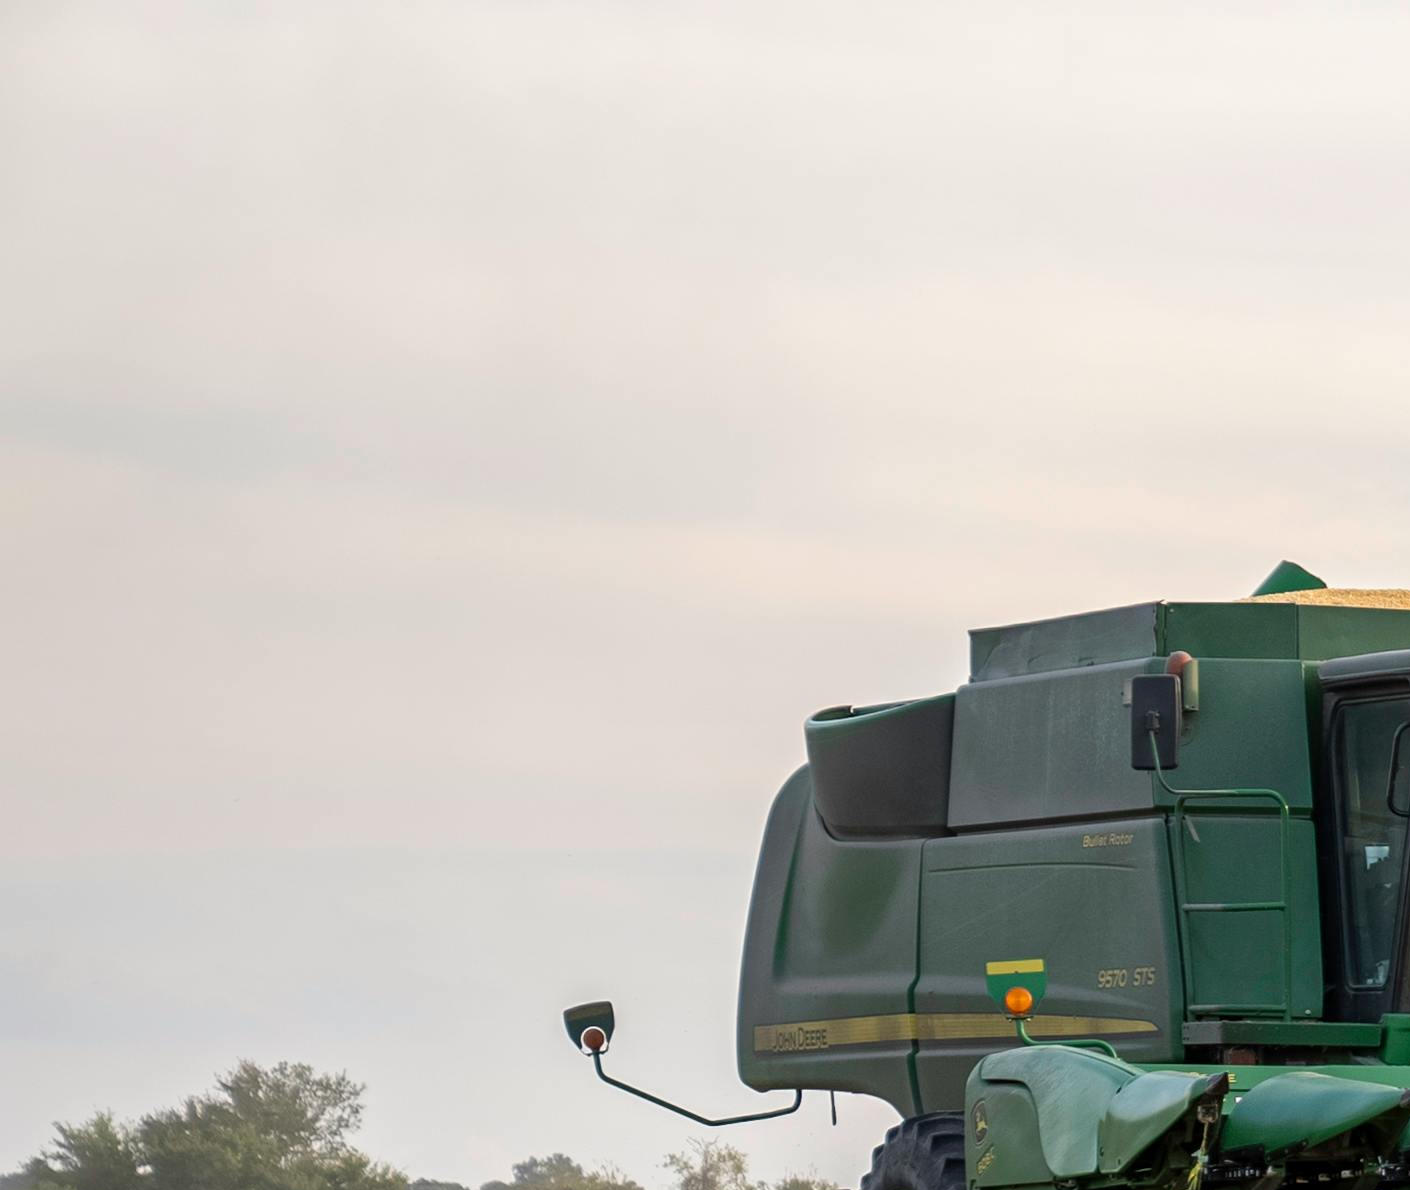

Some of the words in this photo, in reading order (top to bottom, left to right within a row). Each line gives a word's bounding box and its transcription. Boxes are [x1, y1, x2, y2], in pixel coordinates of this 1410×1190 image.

[1109, 832, 1134, 846] Rotor
[1098, 969, 1127, 988] 9570
[1133, 967, 1155, 986] STS
[773, 1030, 798, 1052] JOHN
[798, 1027, 828, 1050] DEERE
